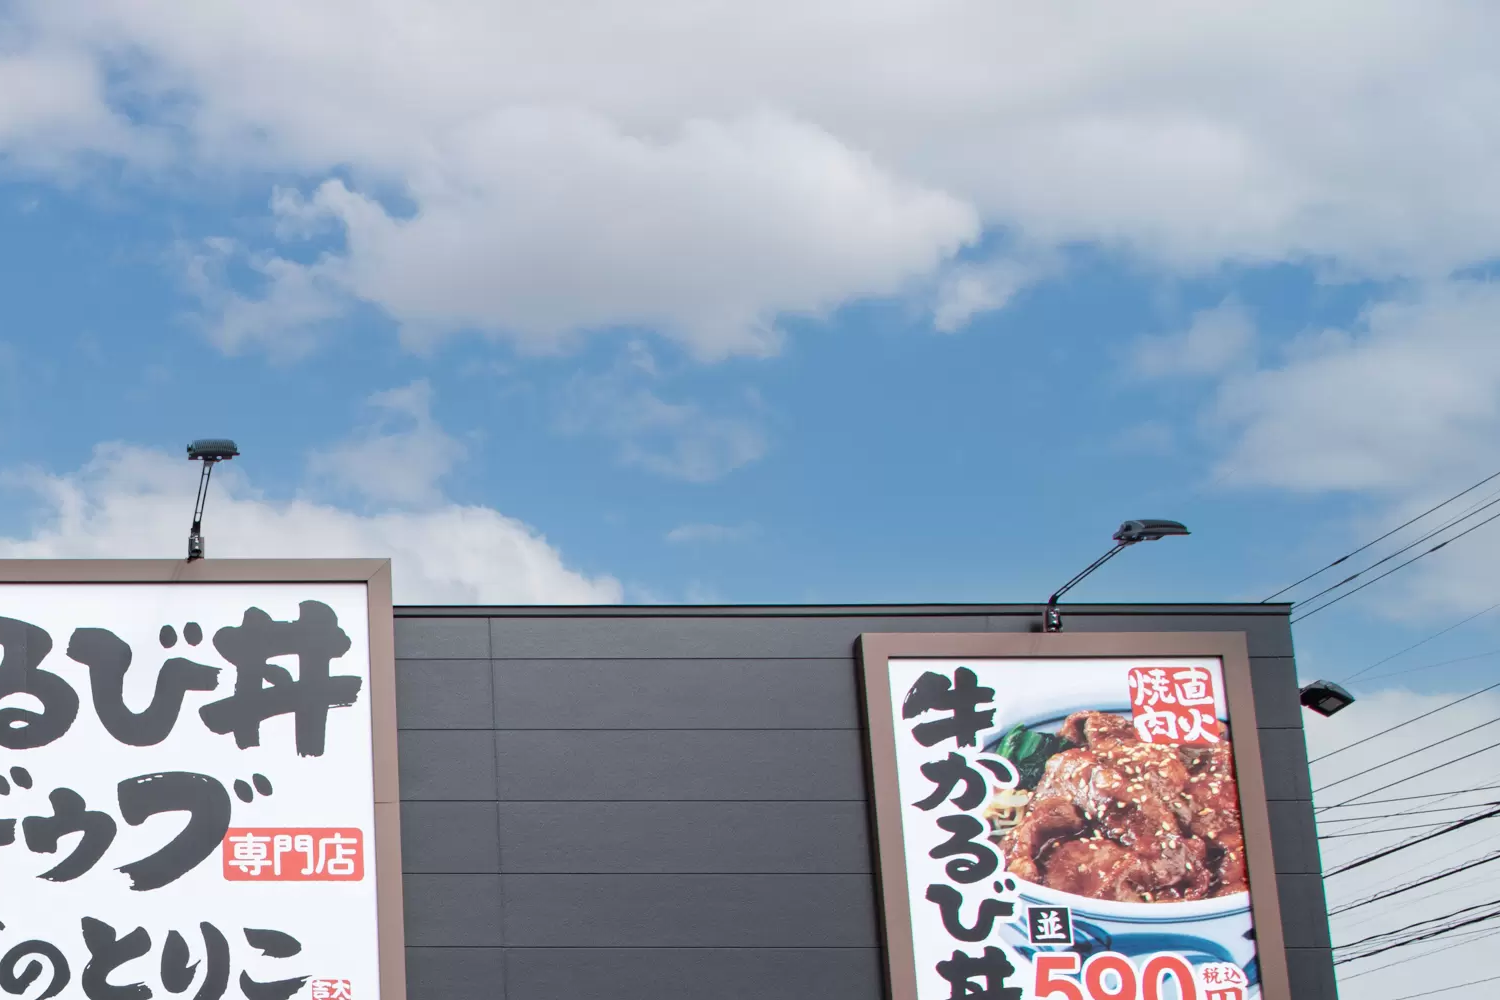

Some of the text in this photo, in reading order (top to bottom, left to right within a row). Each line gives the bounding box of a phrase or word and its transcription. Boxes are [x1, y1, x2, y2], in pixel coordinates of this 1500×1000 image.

[1129, 669, 1177, 743] 焼肉
[1174, 668, 1220, 743] 直火
[228, 832, 358, 876] 専門店
[1035, 912, 1067, 941] 並
[1202, 967, 1244, 985] 税込
